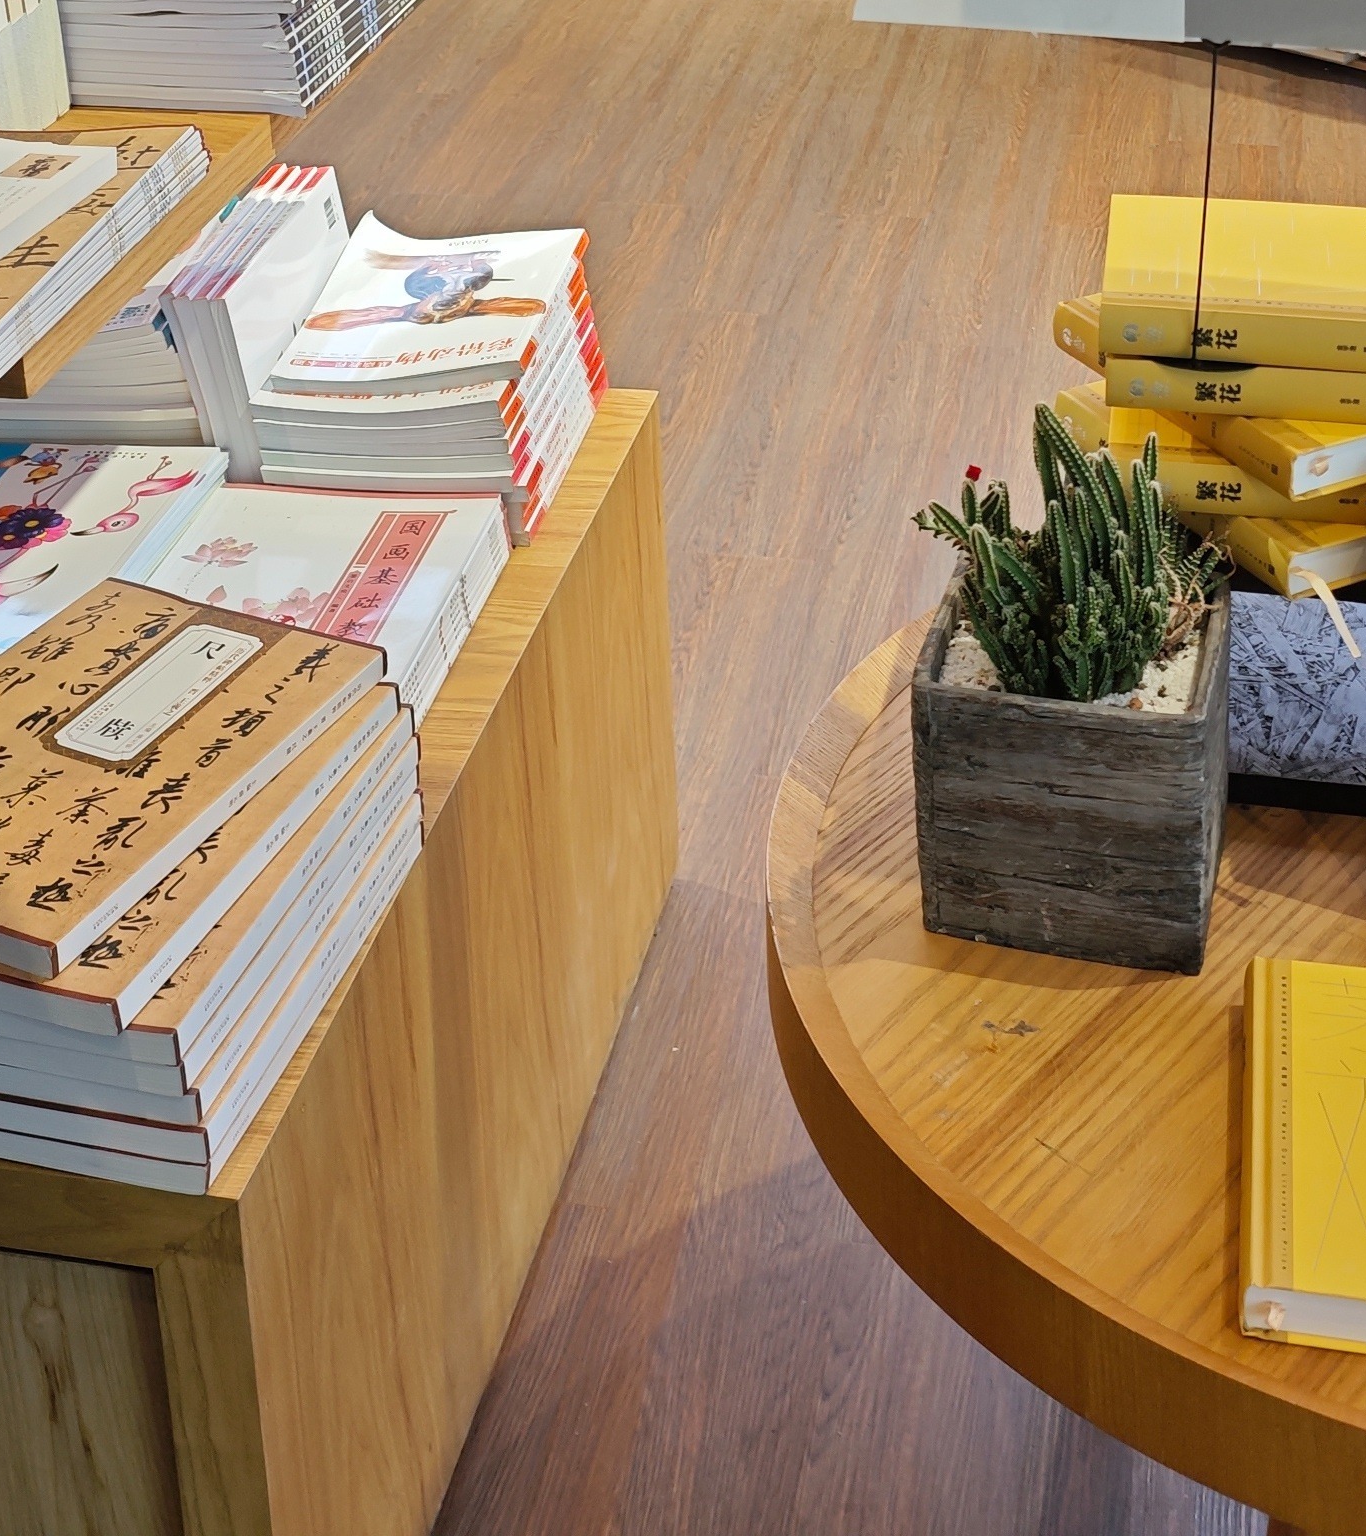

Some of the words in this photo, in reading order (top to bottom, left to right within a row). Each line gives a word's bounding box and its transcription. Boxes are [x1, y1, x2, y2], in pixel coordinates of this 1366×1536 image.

[1191, 328, 1238, 350] 繁花
[394, 336, 518, 366] 彩铅动物
[1195, 381, 1241, 404] 繁花
[1195, 480, 1242, 503] 繁花
